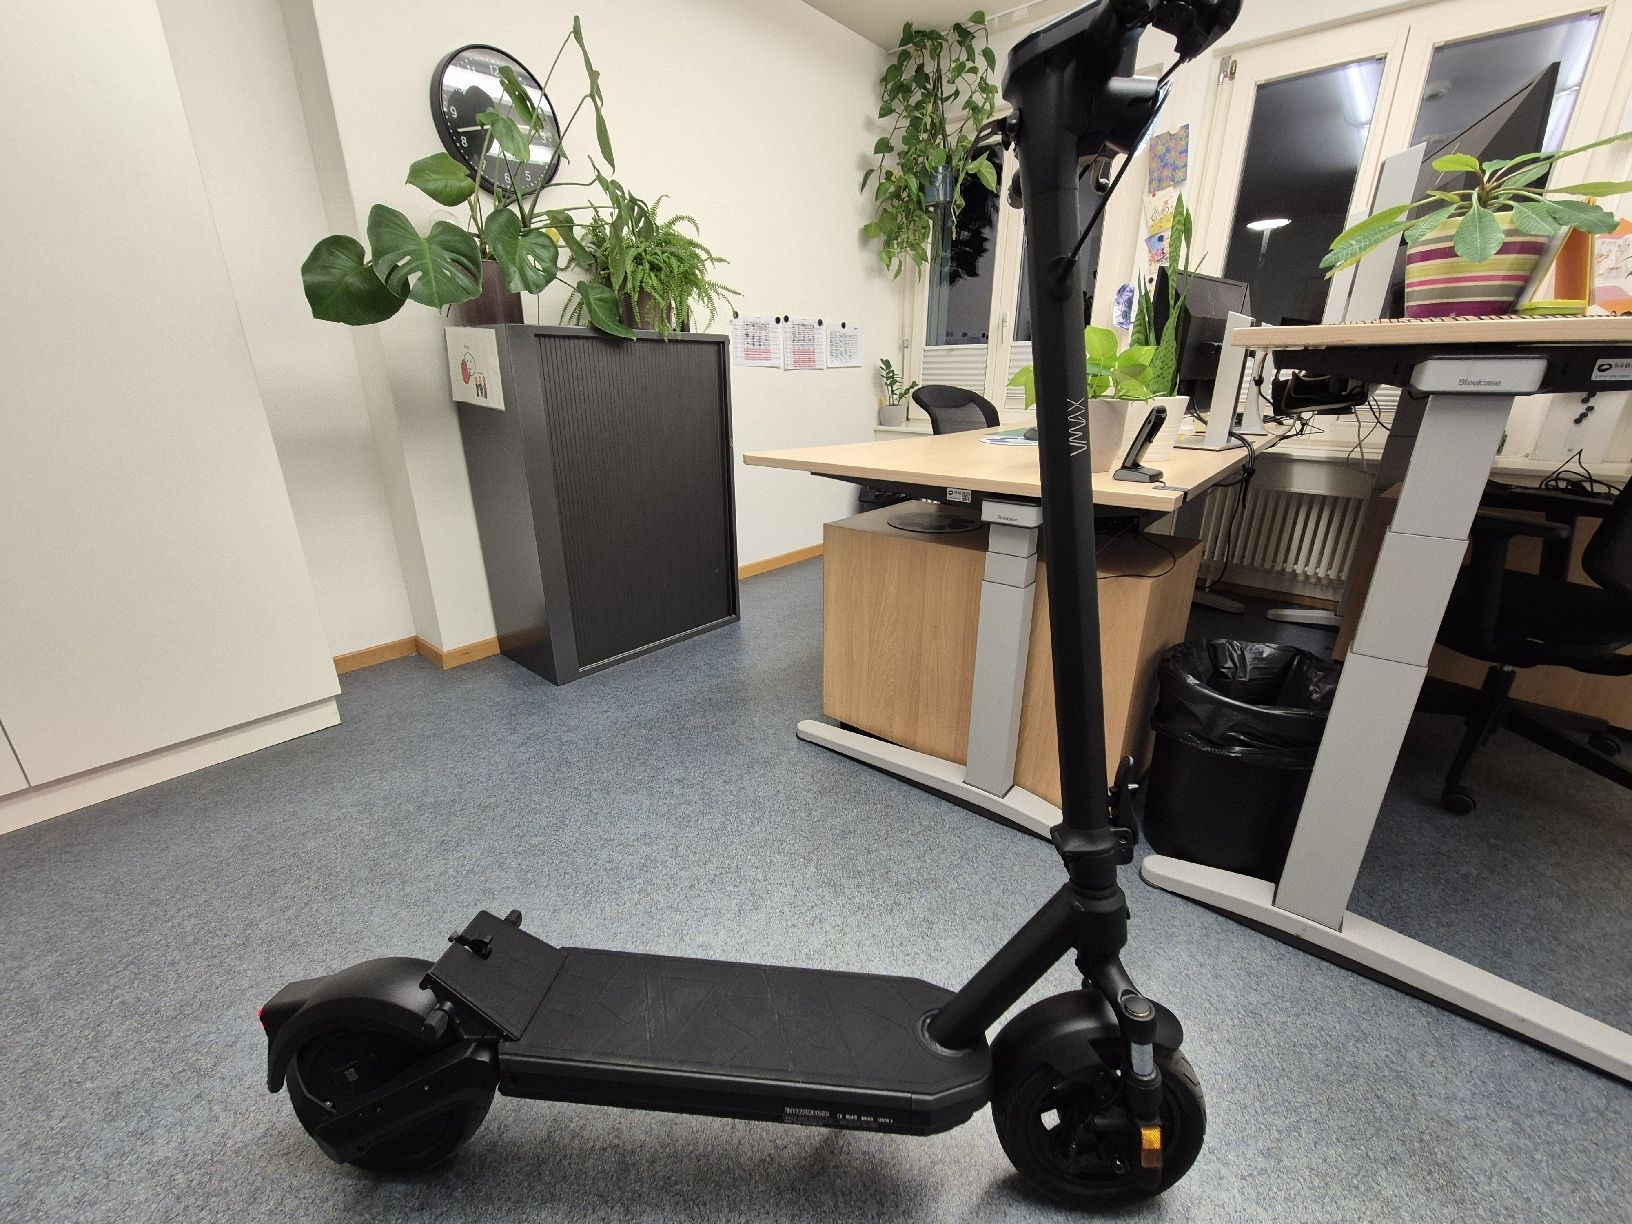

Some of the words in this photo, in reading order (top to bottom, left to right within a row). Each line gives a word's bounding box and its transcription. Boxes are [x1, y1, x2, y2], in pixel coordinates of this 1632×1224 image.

[489, 64, 500, 77] 12
[449, 106, 458, 118] 9
[460, 136, 468, 148] 8
[540, 132, 547, 143] 3
[504, 172, 511, 184] 6
[524, 170, 532, 182] 5
[1458, 378, 1502, 387] Steelcase
[1066, 396, 1088, 457] VMAX
